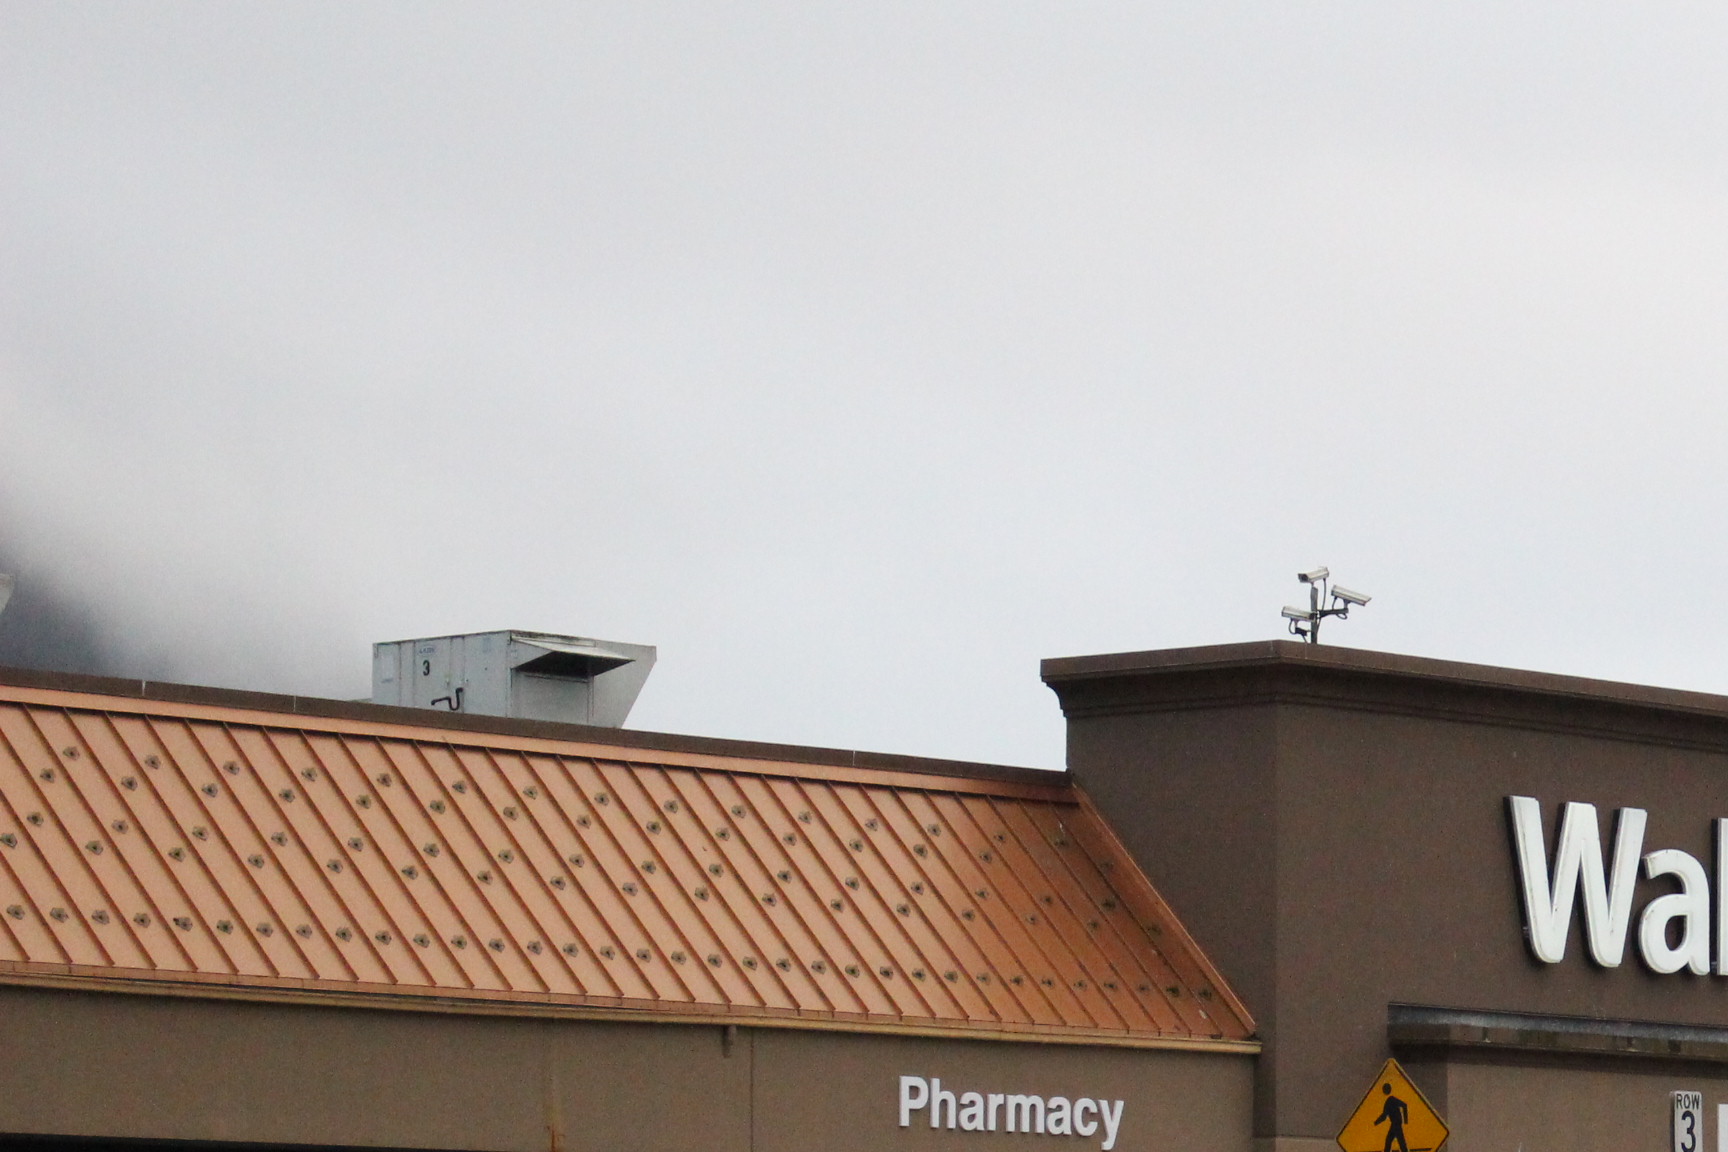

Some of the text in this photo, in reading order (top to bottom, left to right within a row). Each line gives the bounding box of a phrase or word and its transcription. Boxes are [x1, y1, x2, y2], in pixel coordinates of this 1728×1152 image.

[422, 659, 430, 676] 3
[1676, 1094, 1700, 1110] ROW
[898, 1075, 1124, 1151] Pharmacy
